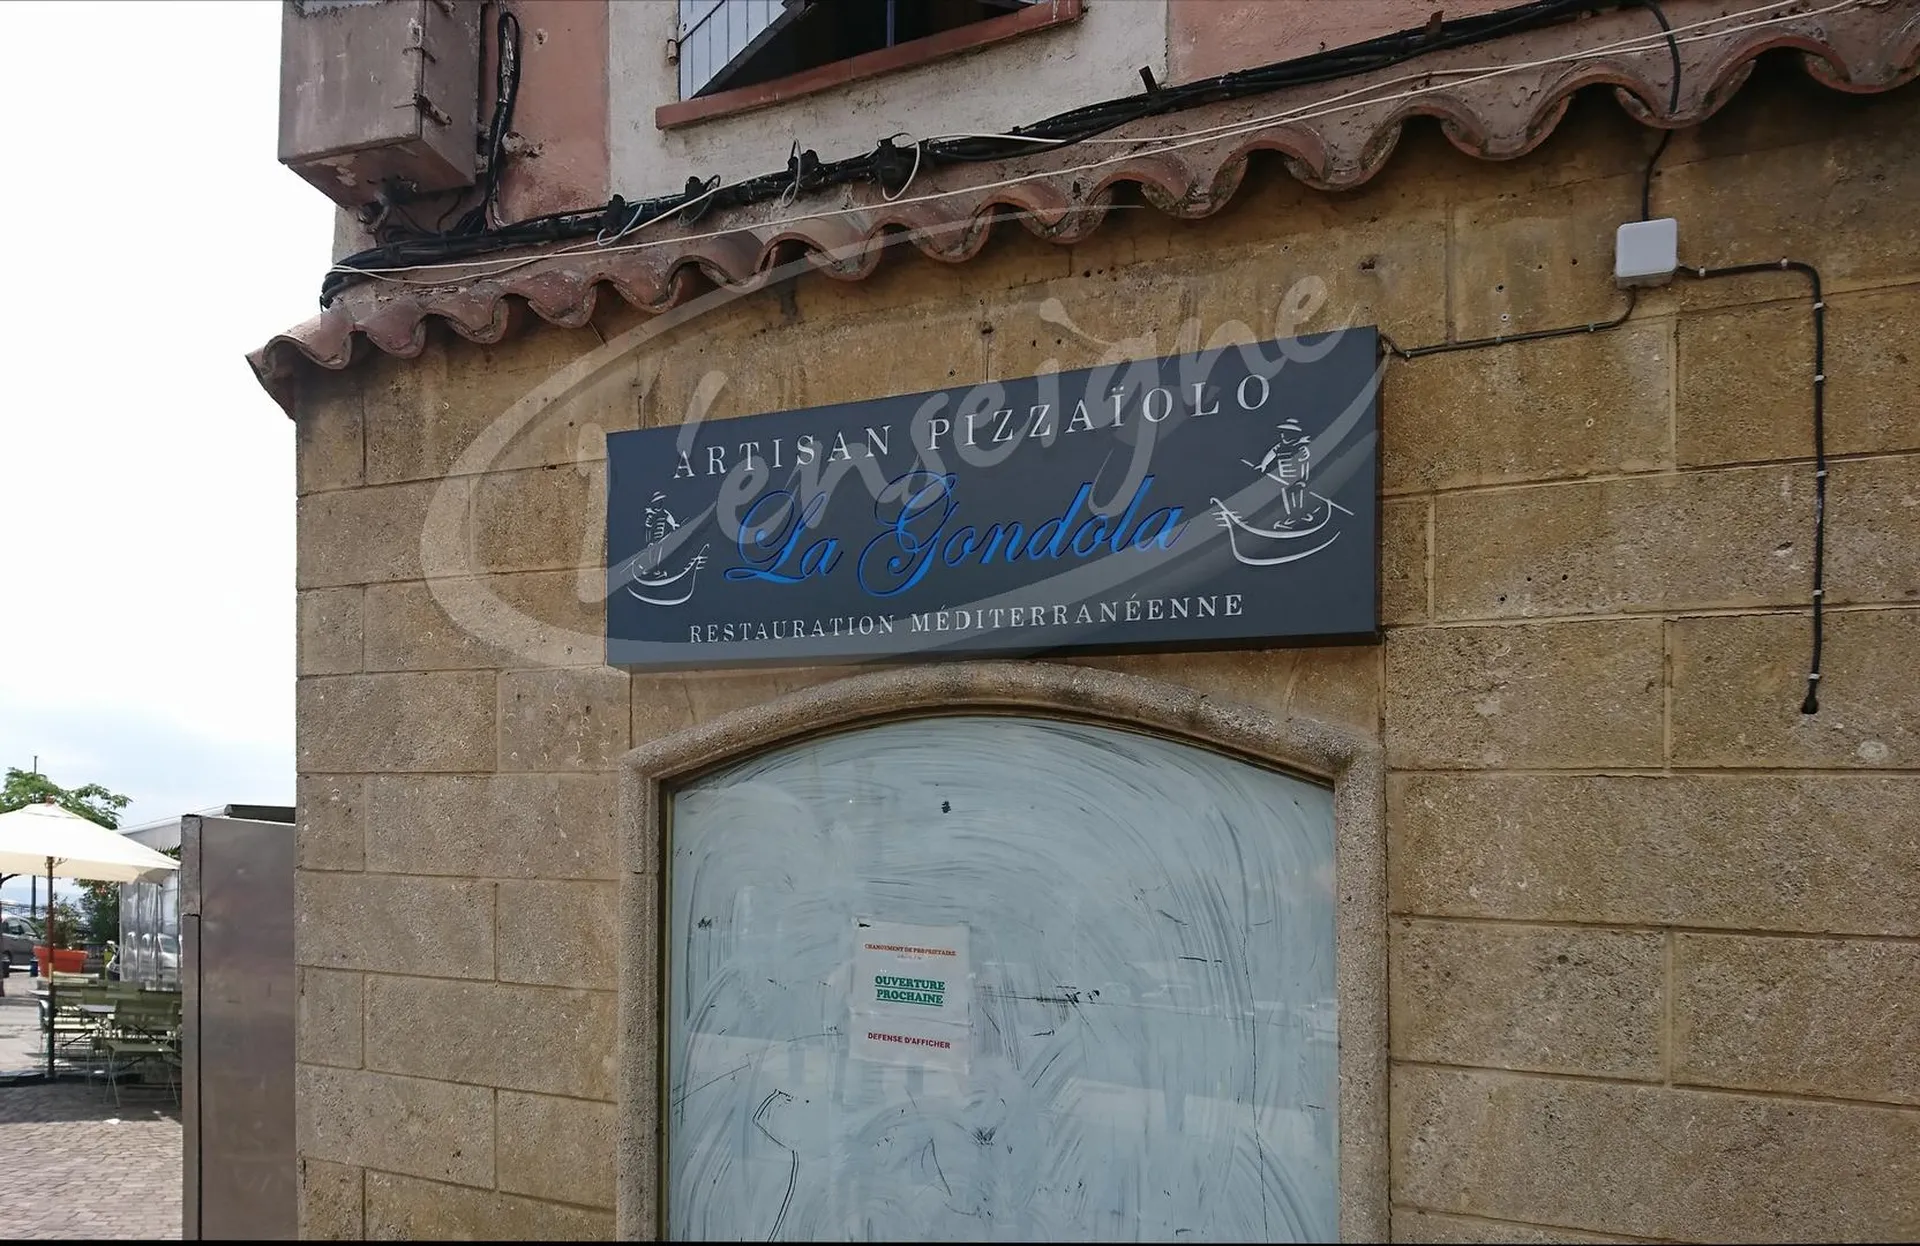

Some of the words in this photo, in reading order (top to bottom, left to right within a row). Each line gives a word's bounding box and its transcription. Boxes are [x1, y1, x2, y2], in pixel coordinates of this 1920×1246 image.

[673, 425, 892, 480] ARTISAN
[927, 374, 1270, 451] PIZZAÏOLO
[723, 489, 844, 585] La
[857, 470, 1190, 597] Gondola
[689, 614, 895, 644] RESTAURATION
[910, 592, 1244, 633] MÉDITERRANÉENNE
[874, 975, 946, 991] OUVERTURE
[876, 989, 944, 1005] PROCHAINE
[867, 1032, 903, 1044] DEFENSE
[904, 1036, 951, 1049] D'AFFICHER
